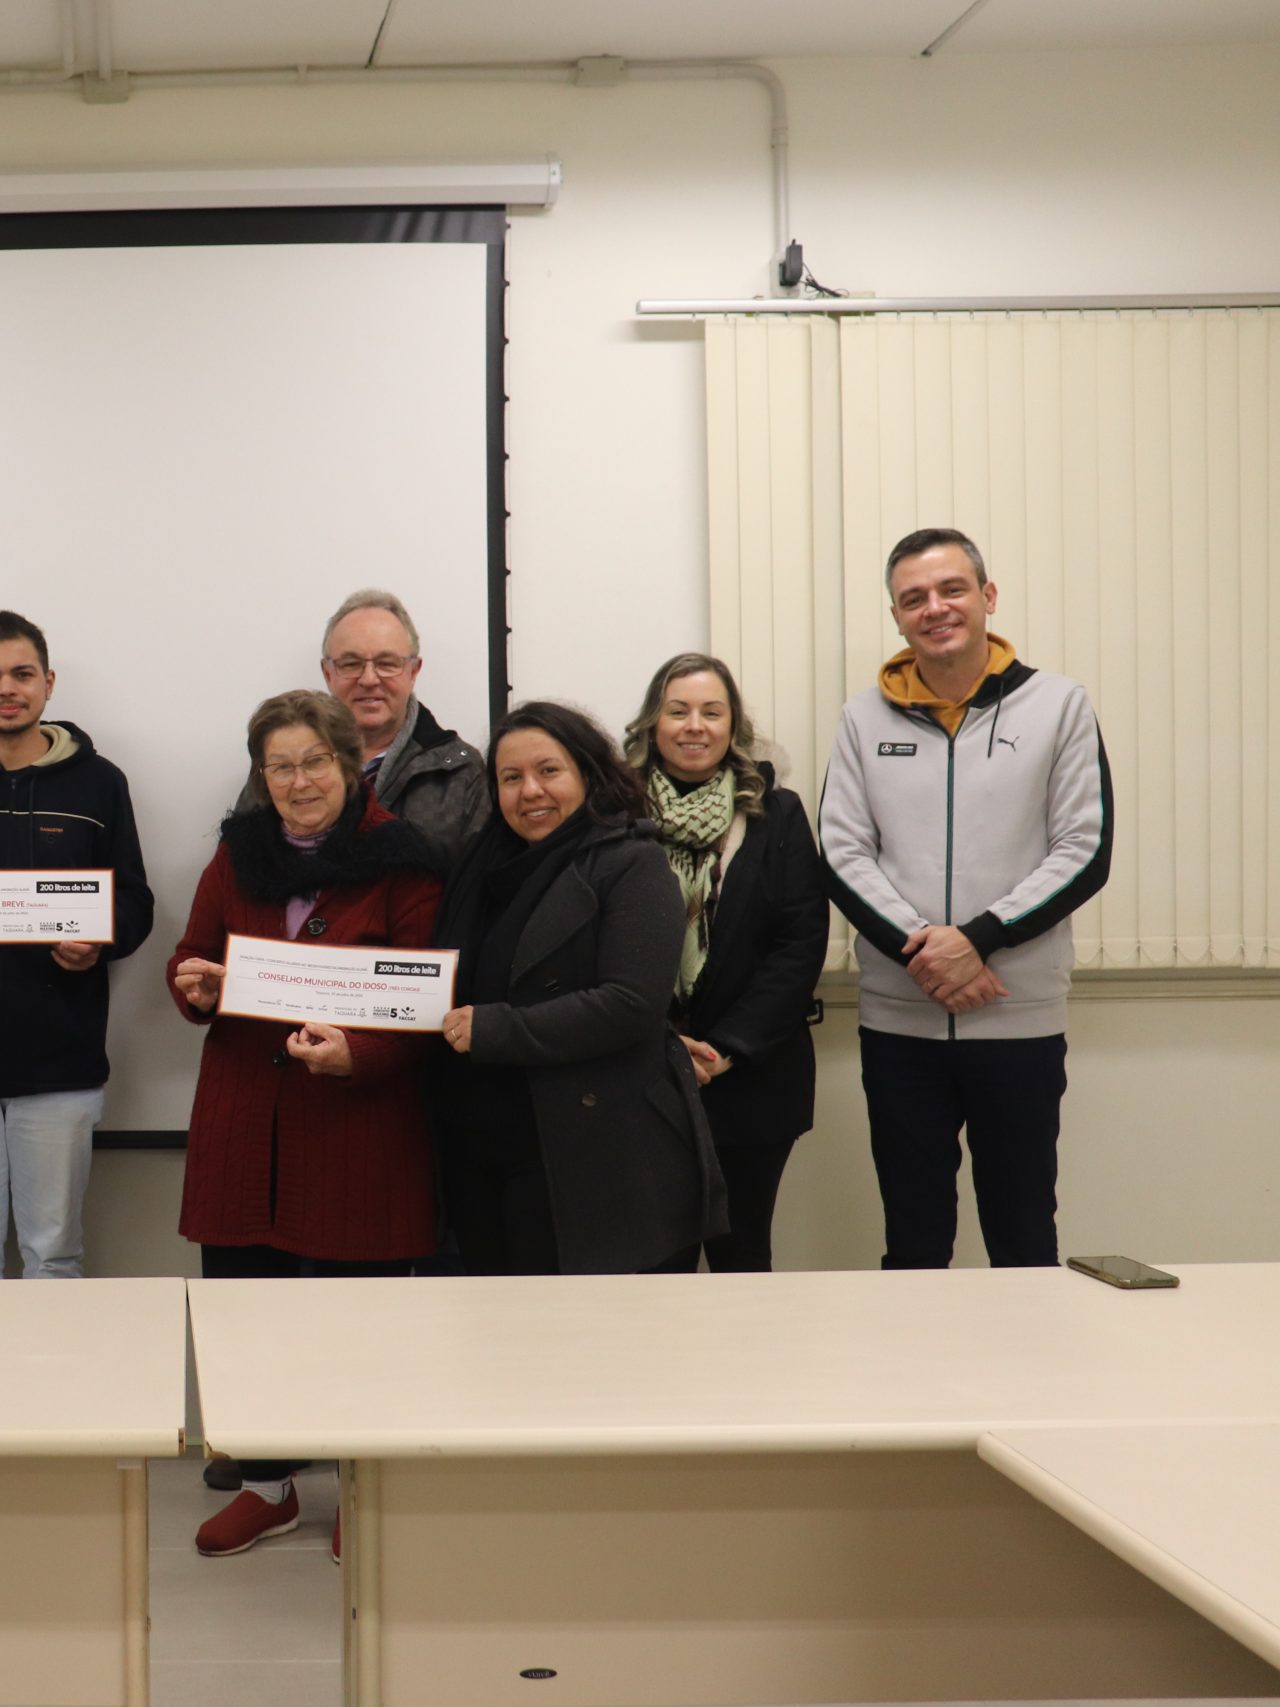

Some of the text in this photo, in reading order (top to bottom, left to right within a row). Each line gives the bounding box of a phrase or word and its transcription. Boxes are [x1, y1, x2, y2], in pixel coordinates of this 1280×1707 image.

[55, 883, 70, 891] litros
[81, 883, 96, 891] leite
[1, 900, 25, 908] BREVE
[56, 922, 63, 932] 5
[377, 964, 437, 975] 200 litros de leite
[257, 971, 303, 984] CONSELHO
[304, 977, 348, 989] MUNICIPAL
[349, 981, 361, 989] DO
[362, 982, 388, 990] IDOSO
[389, 1008, 398, 1018] 5
